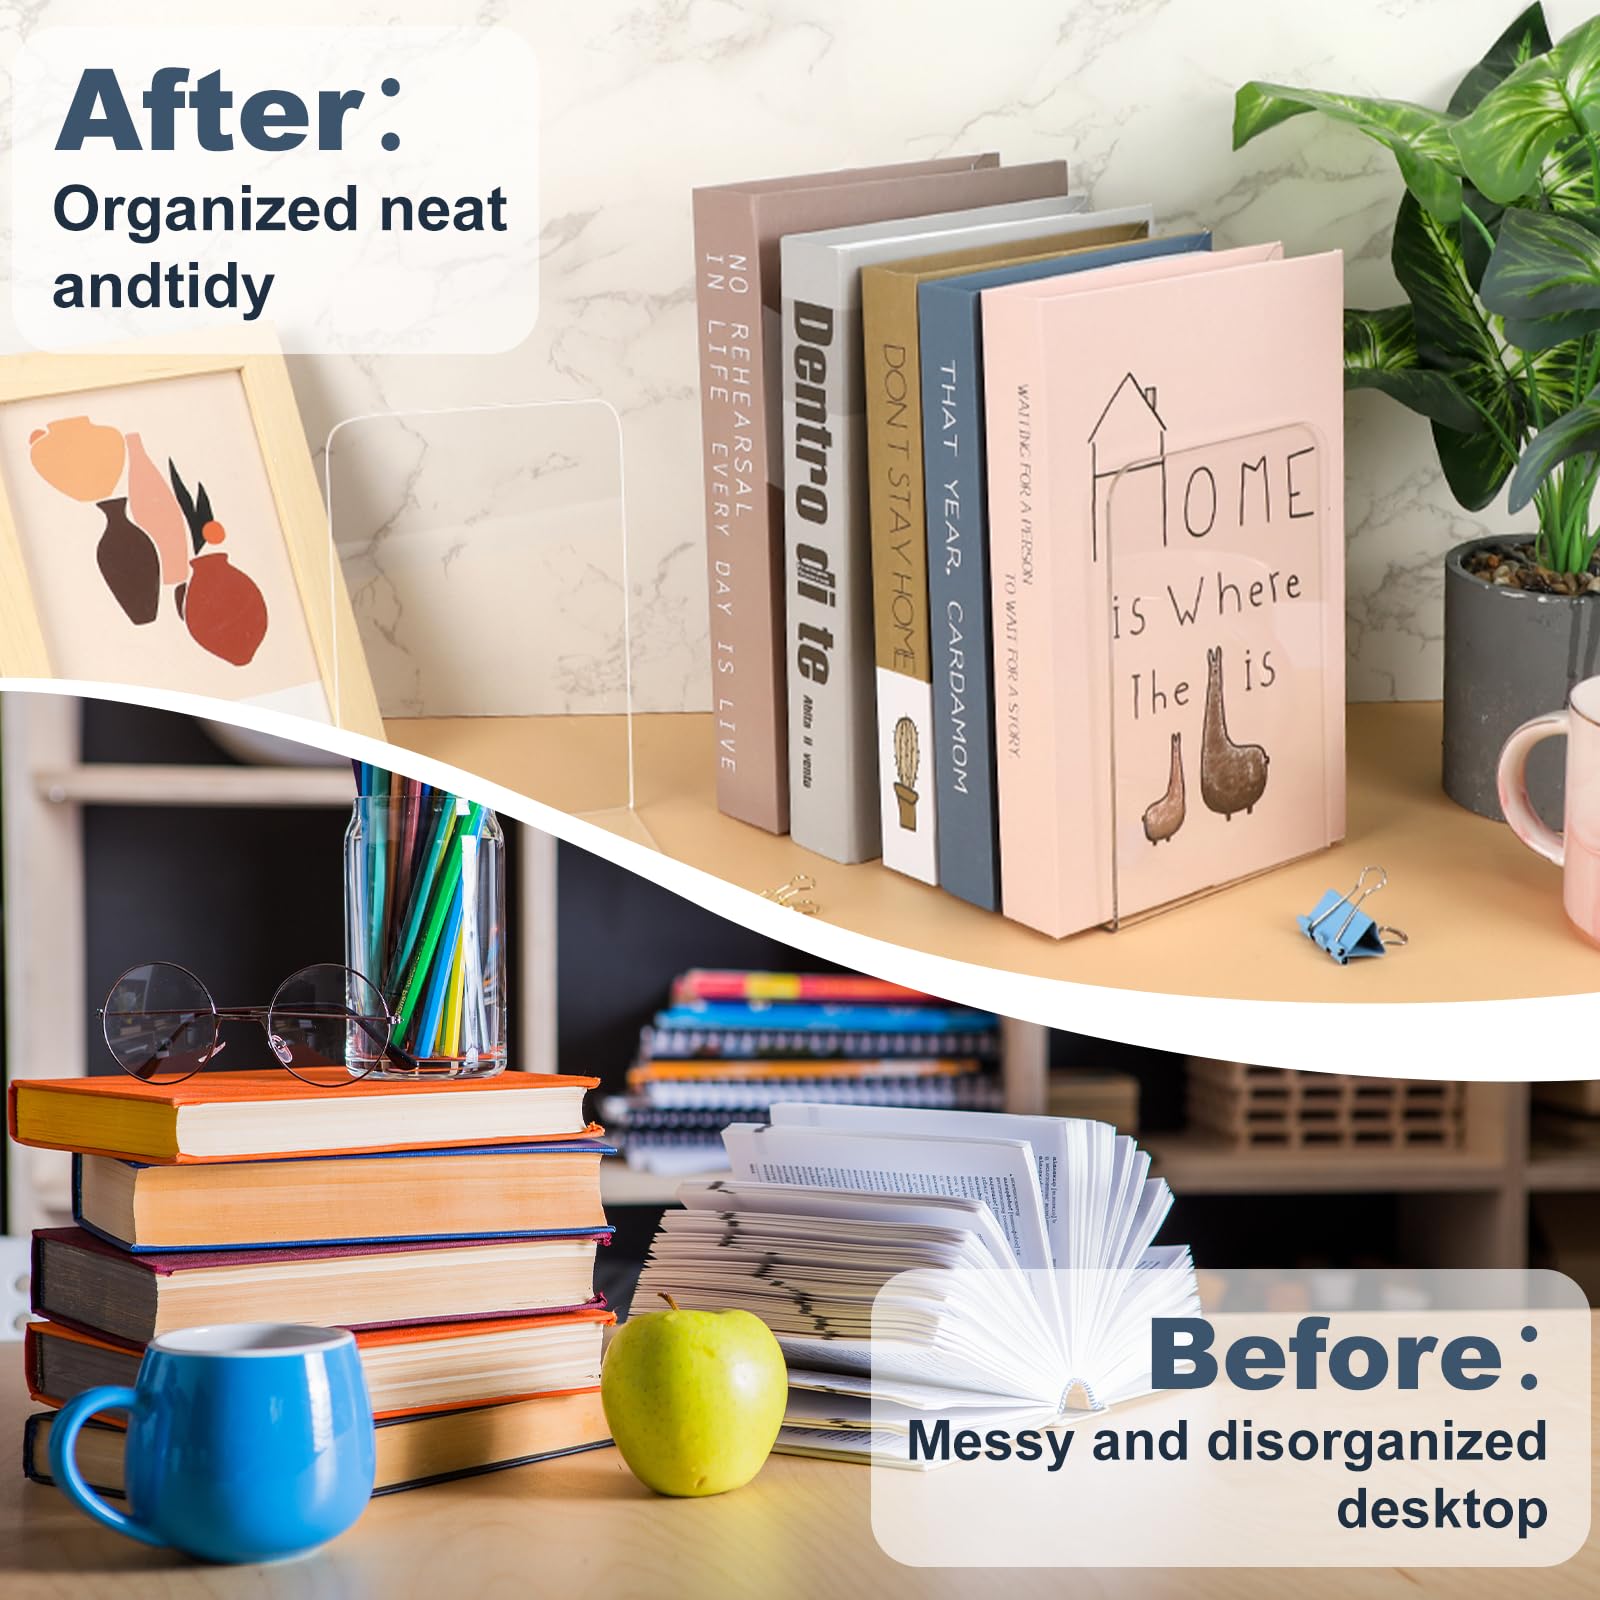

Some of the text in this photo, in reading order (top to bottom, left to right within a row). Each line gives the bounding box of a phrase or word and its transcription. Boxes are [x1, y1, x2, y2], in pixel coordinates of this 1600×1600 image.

[727, 254, 753, 518] NO REHEARSAL
[940, 359, 958, 457] THAT
[706, 253, 736, 772] IN LIFE EVERY DAY IS LIVE
[793, 299, 836, 686] Dentro di te
[887, 466, 912, 565] STAY
[1019, 462, 1032, 497] FOR
[1019, 499, 1033, 516] A
[1091, 431, 1315, 562] HOME
[1004, 573, 1017, 597] TO
[1020, 518, 1034, 587] PERSON
[891, 571, 917, 677] HOME
[1112, 571, 1302, 640] is Where
[947, 600, 969, 794] CARDAMOM
[1007, 647, 1019, 682] FOR
[1007, 683, 1019, 700] A
[1131, 648, 1277, 720] The is
